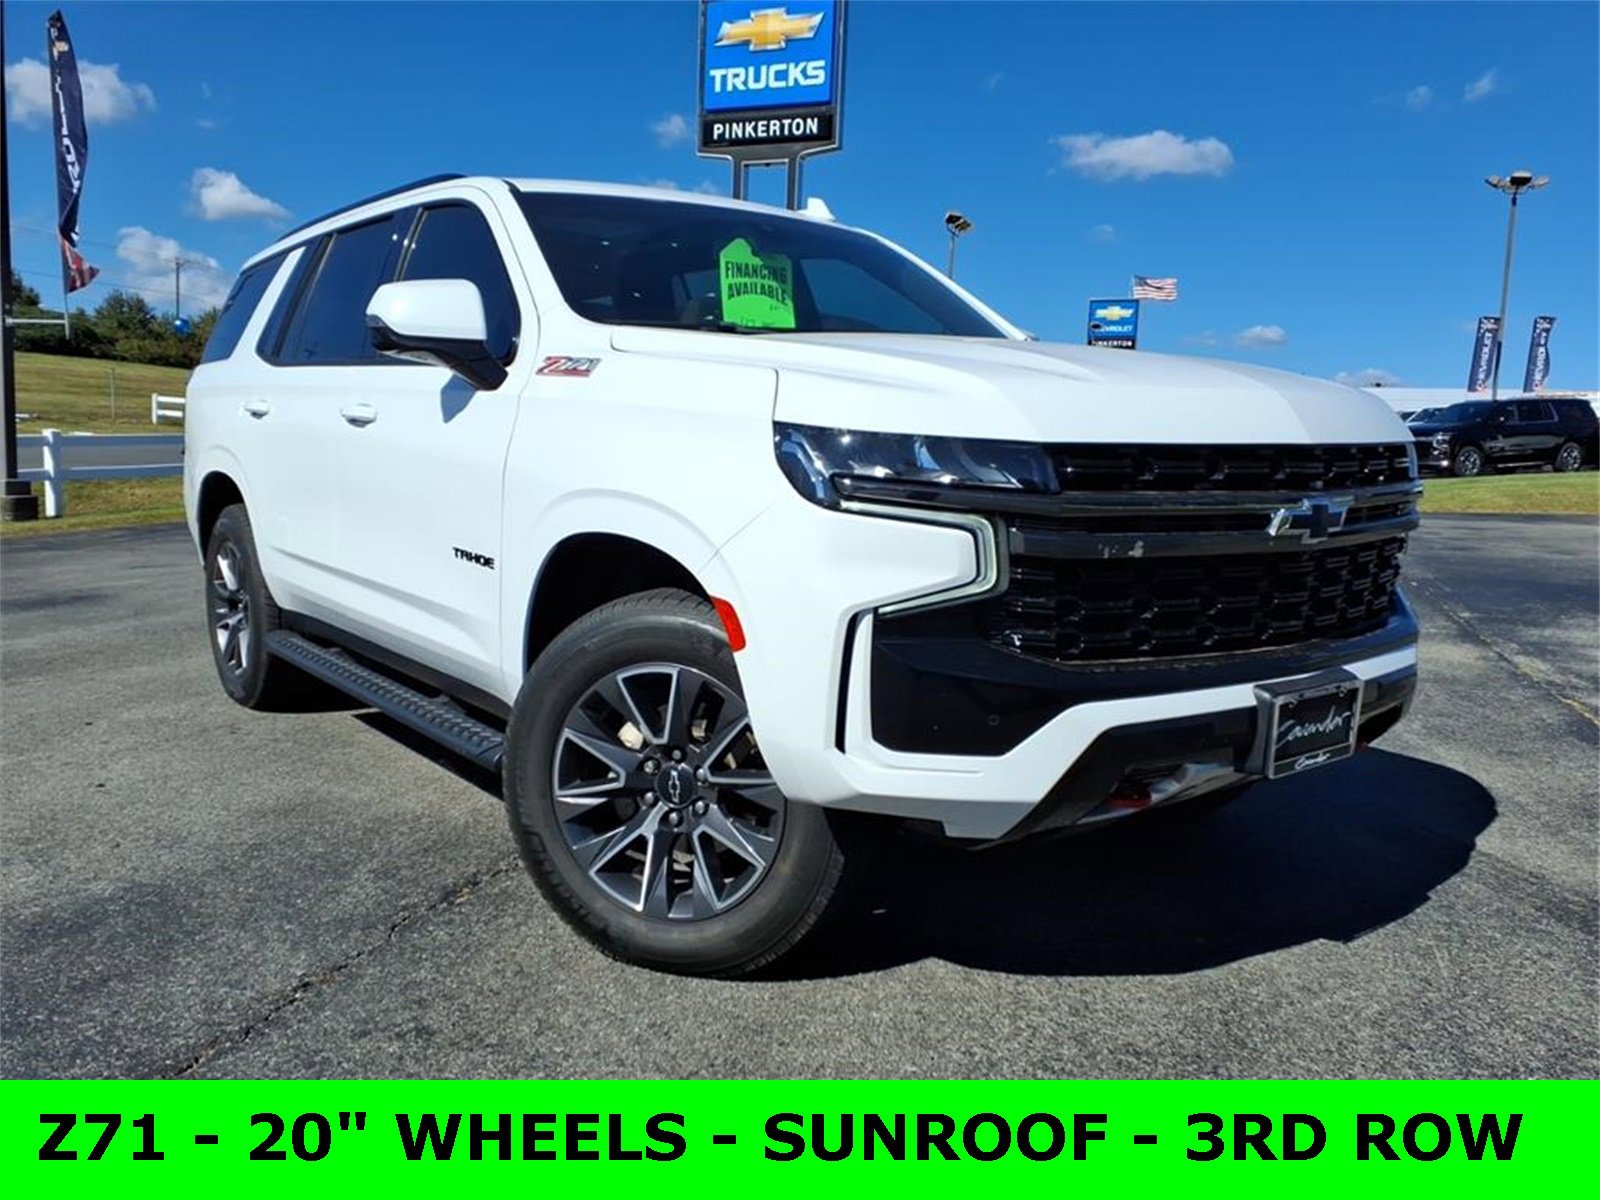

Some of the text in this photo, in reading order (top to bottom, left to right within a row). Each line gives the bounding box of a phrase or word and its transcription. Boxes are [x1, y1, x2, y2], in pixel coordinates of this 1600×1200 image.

[709, 60, 826, 93] TRUCKS
[713, 117, 819, 140] PINKERTON
[728, 281, 789, 306] AVAILABLE
[536, 356, 602, 378] Z71
[452, 547, 495, 570] TAHOE
